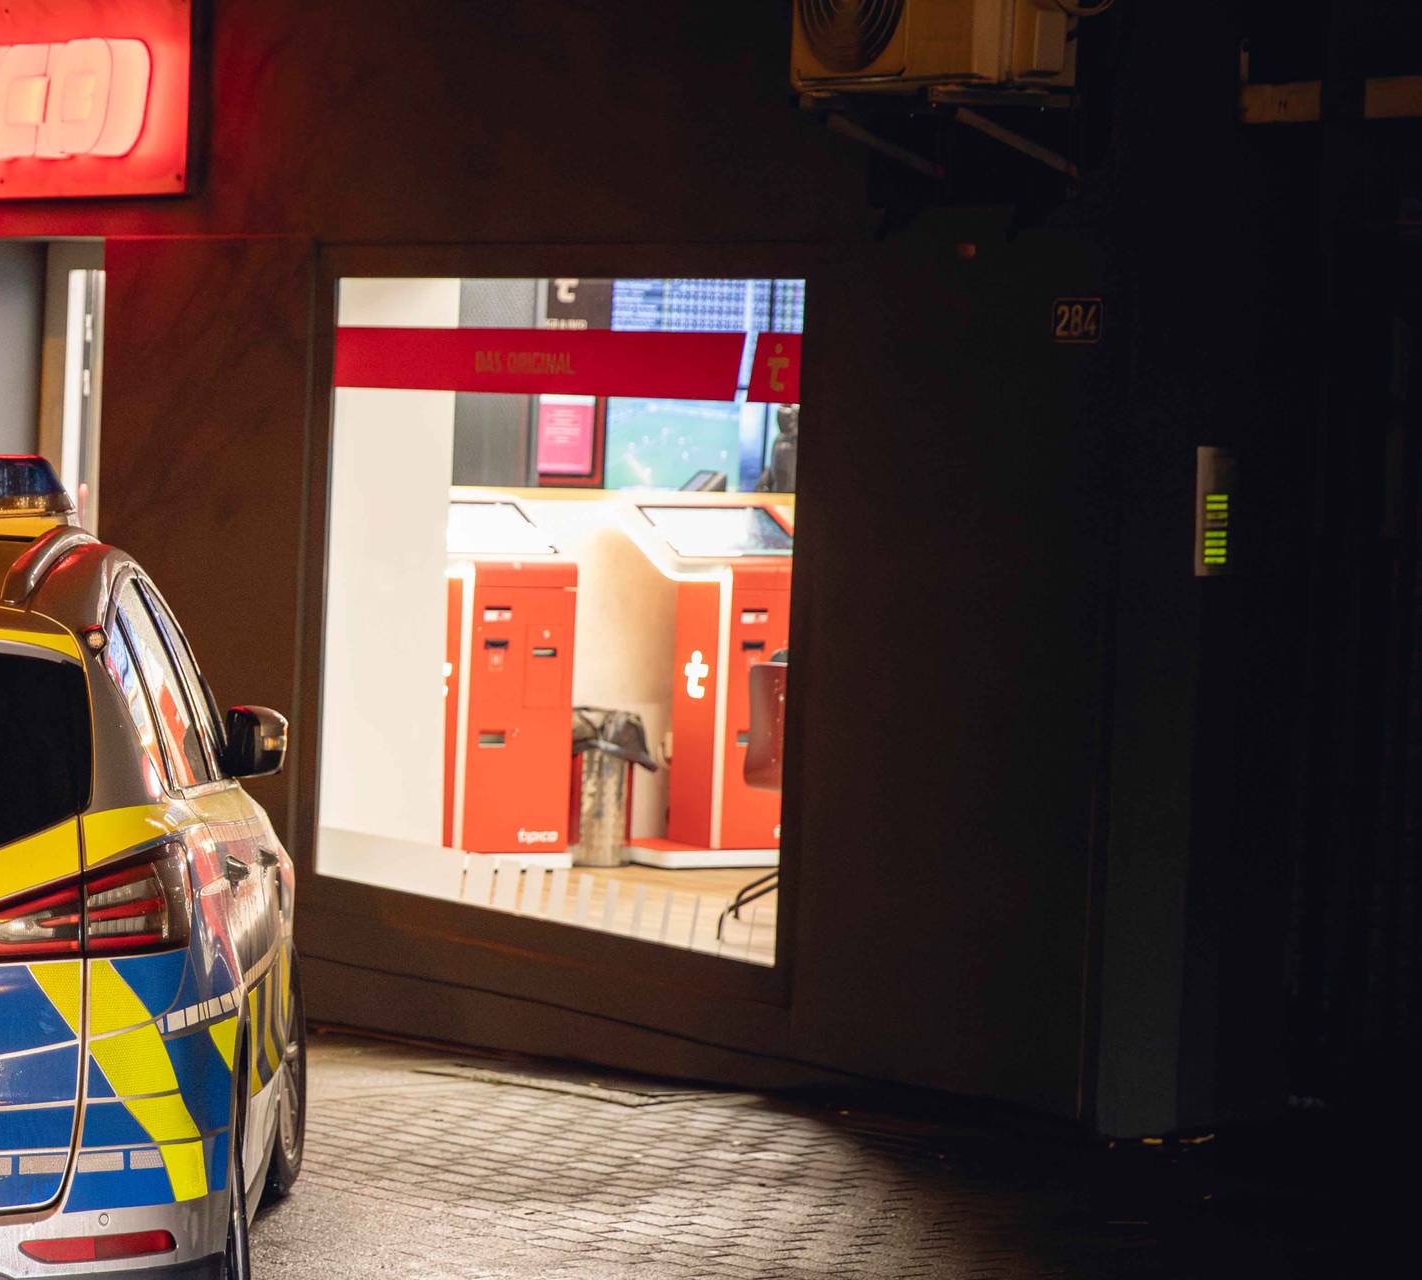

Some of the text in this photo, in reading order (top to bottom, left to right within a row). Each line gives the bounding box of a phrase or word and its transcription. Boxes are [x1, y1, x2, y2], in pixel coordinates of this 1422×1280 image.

[1055, 303, 1098, 337] 284
[474, 350, 578, 375] DAS ORIGINAL
